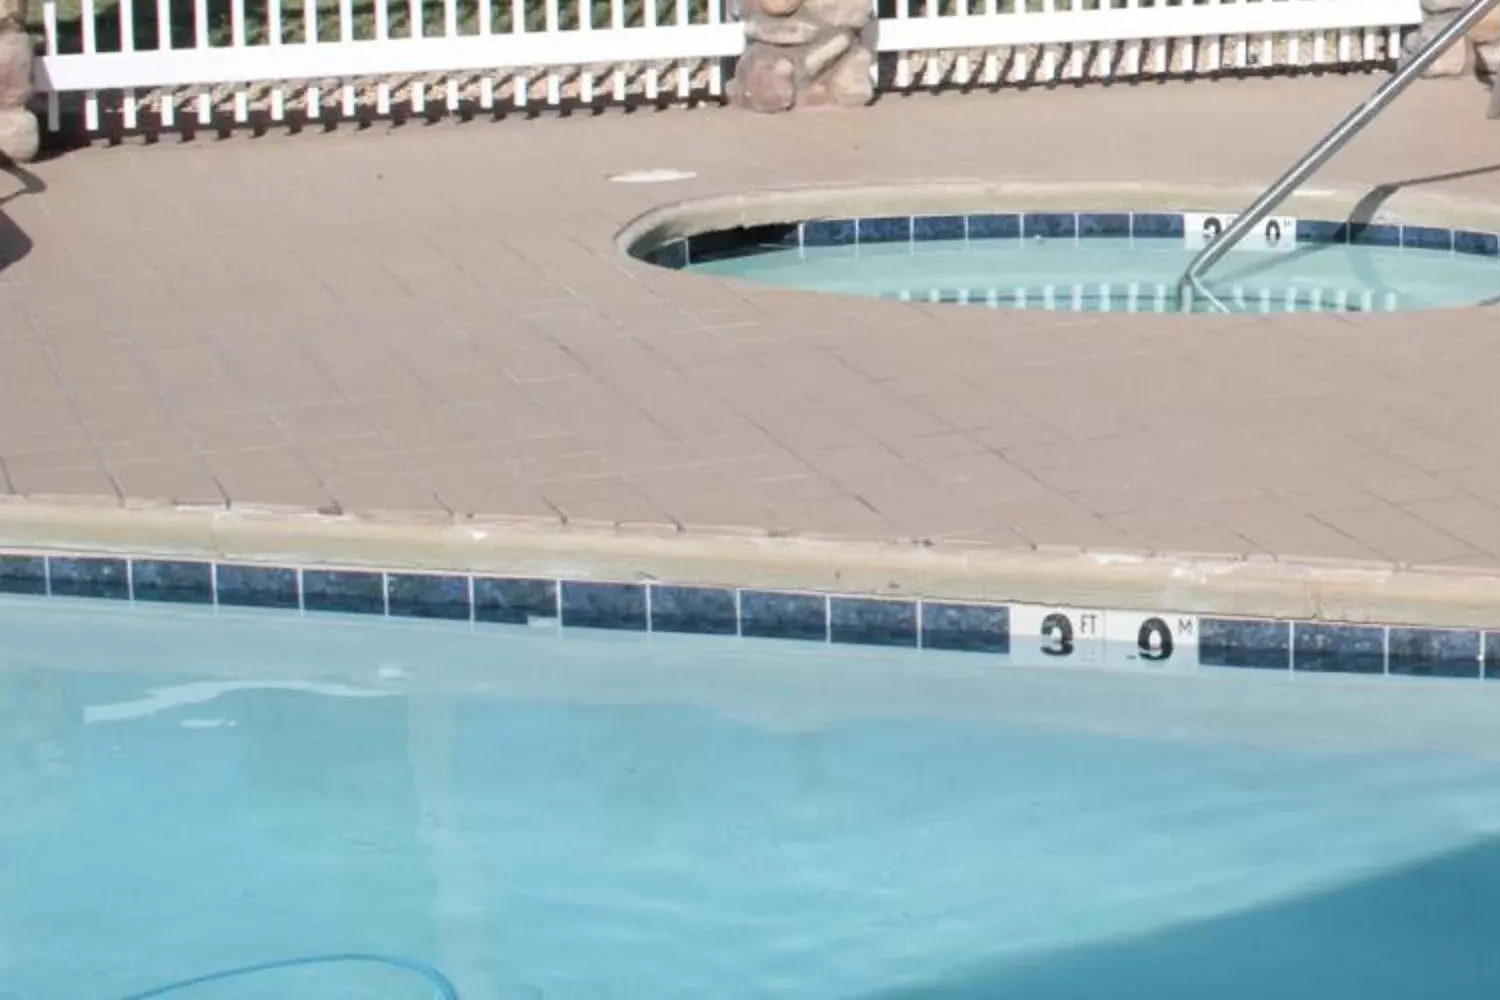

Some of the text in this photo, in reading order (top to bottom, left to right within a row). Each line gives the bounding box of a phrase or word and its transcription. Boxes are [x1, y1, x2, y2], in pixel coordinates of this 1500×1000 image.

[1040, 612, 1074, 657] 3
[1080, 614, 1097, 635] FT
[1178, 618, 1193, 637] M
